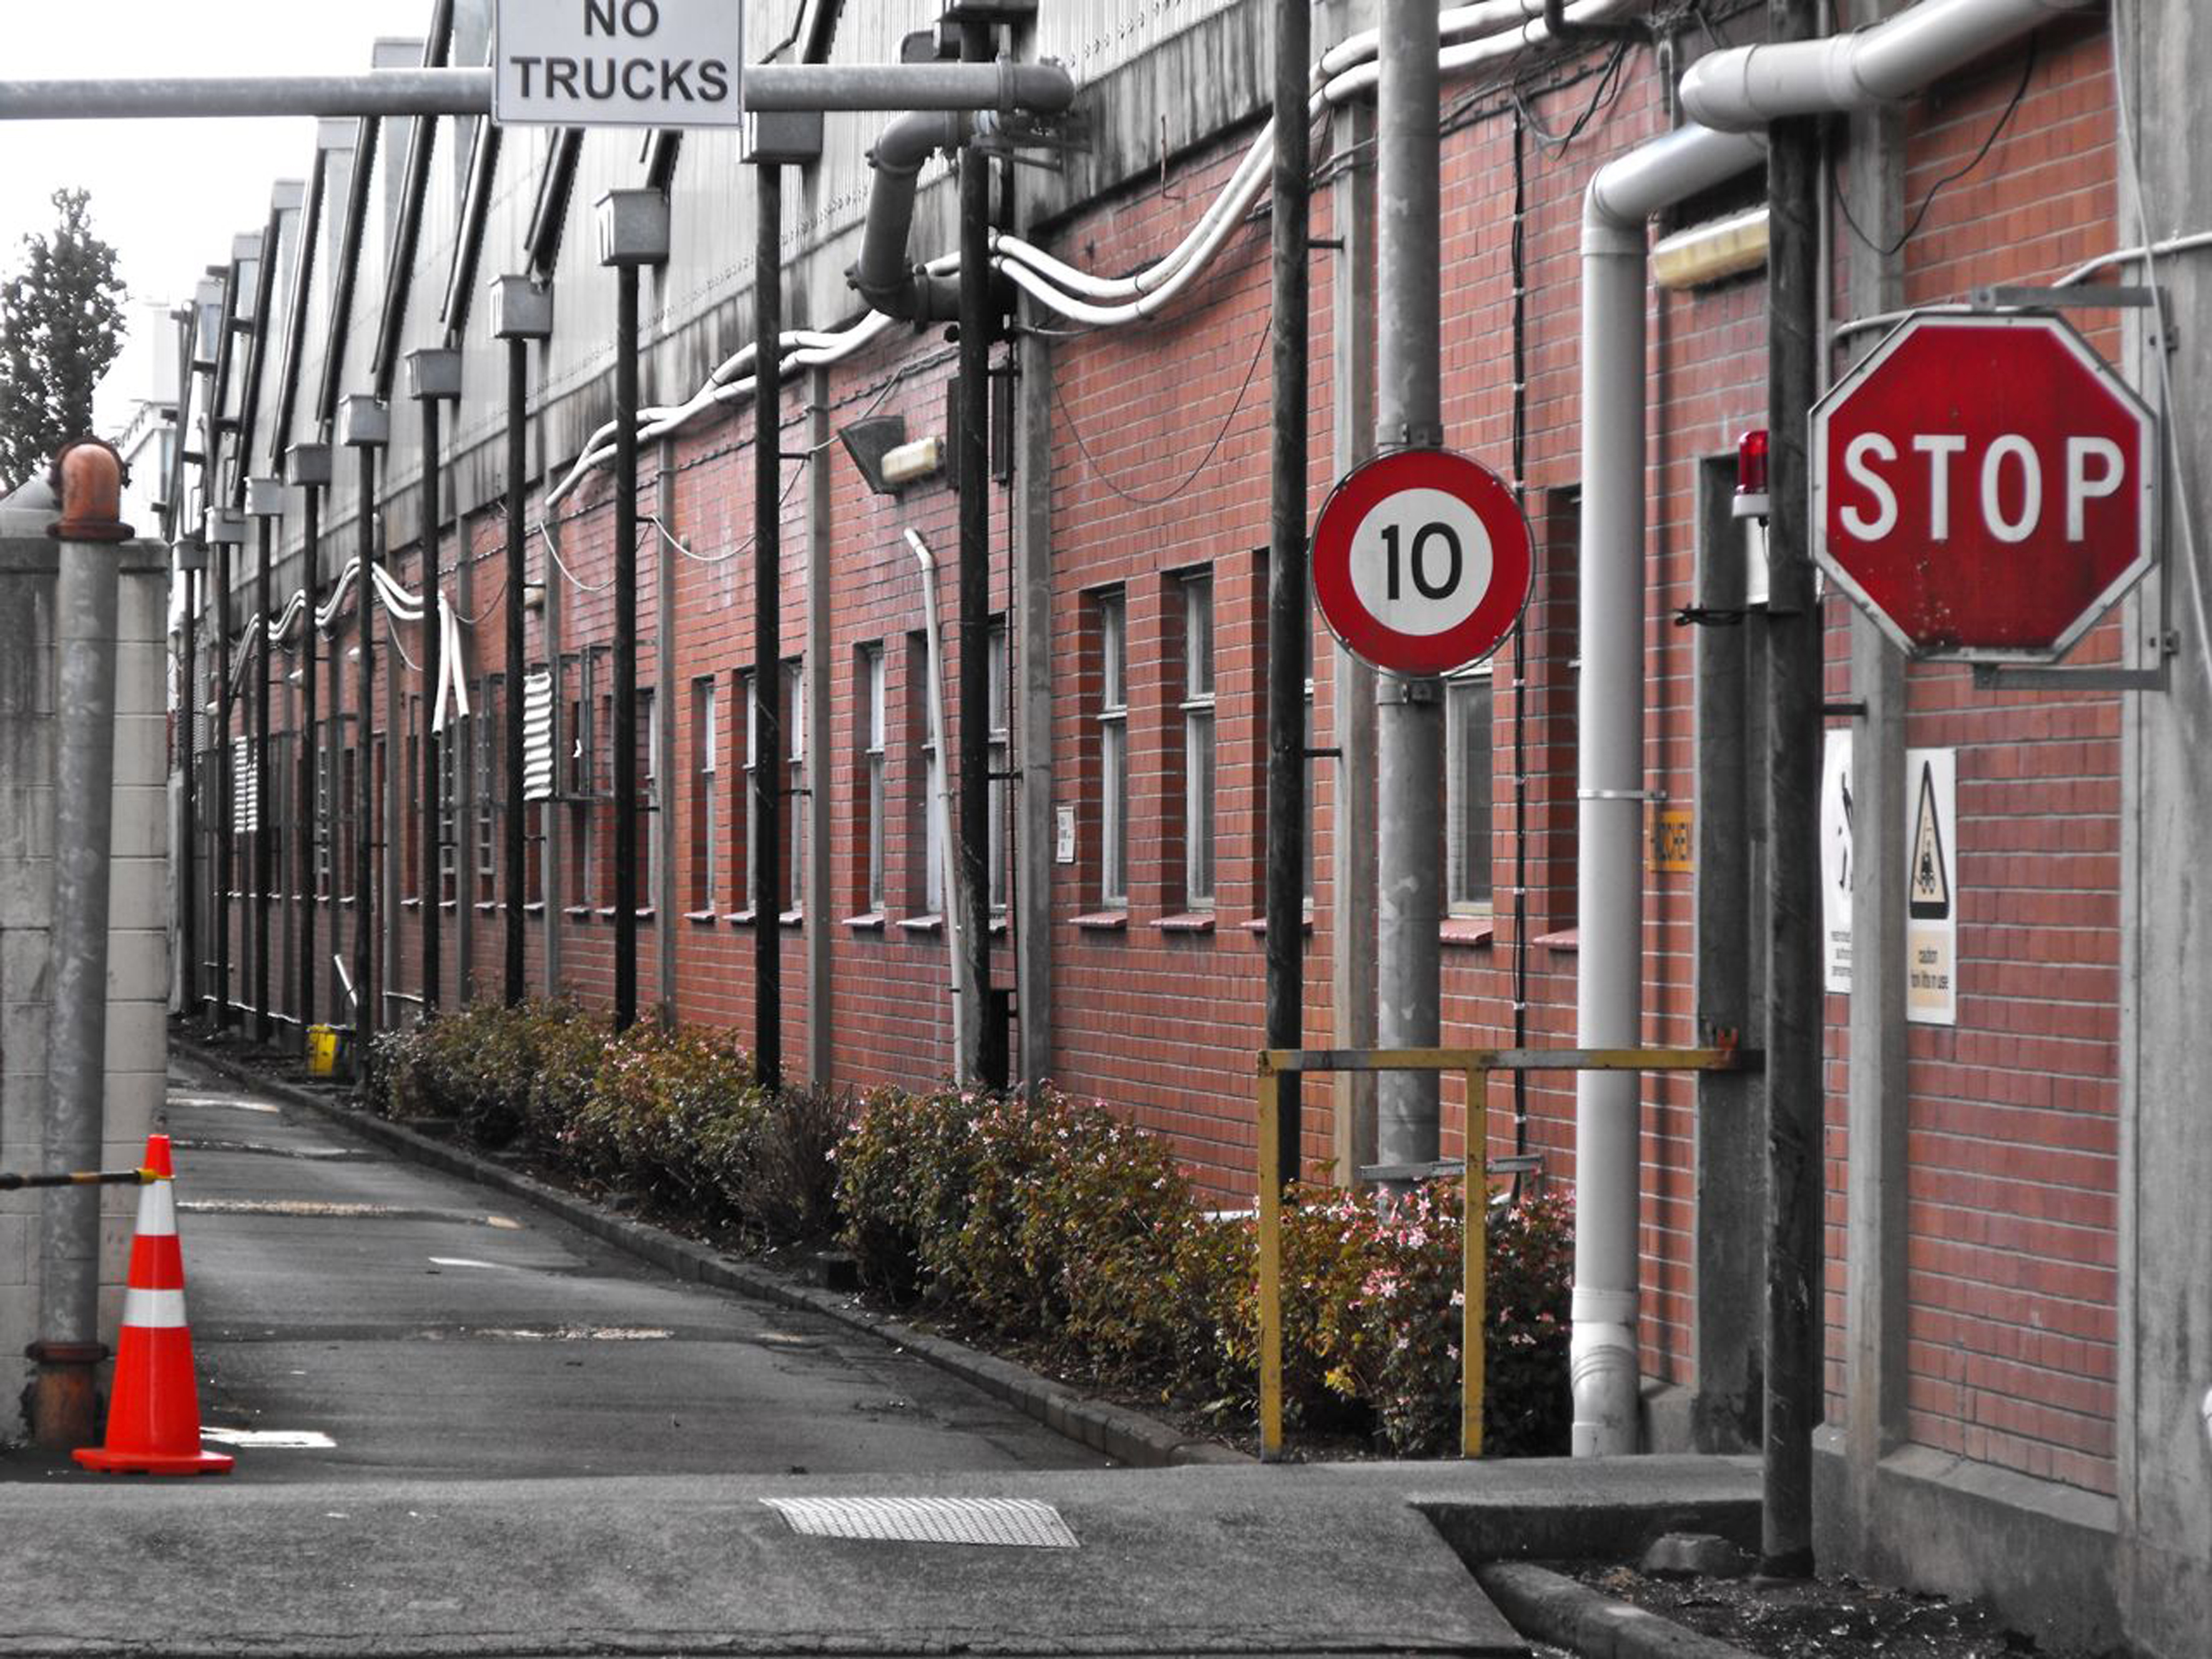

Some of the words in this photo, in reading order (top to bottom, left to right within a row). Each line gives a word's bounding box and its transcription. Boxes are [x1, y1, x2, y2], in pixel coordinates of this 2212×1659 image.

[584, 0, 659, 37] NO
[509, 56, 728, 102] TRUCKS
[1839, 431, 2125, 543] STOP
[1380, 521, 1463, 601] 10
